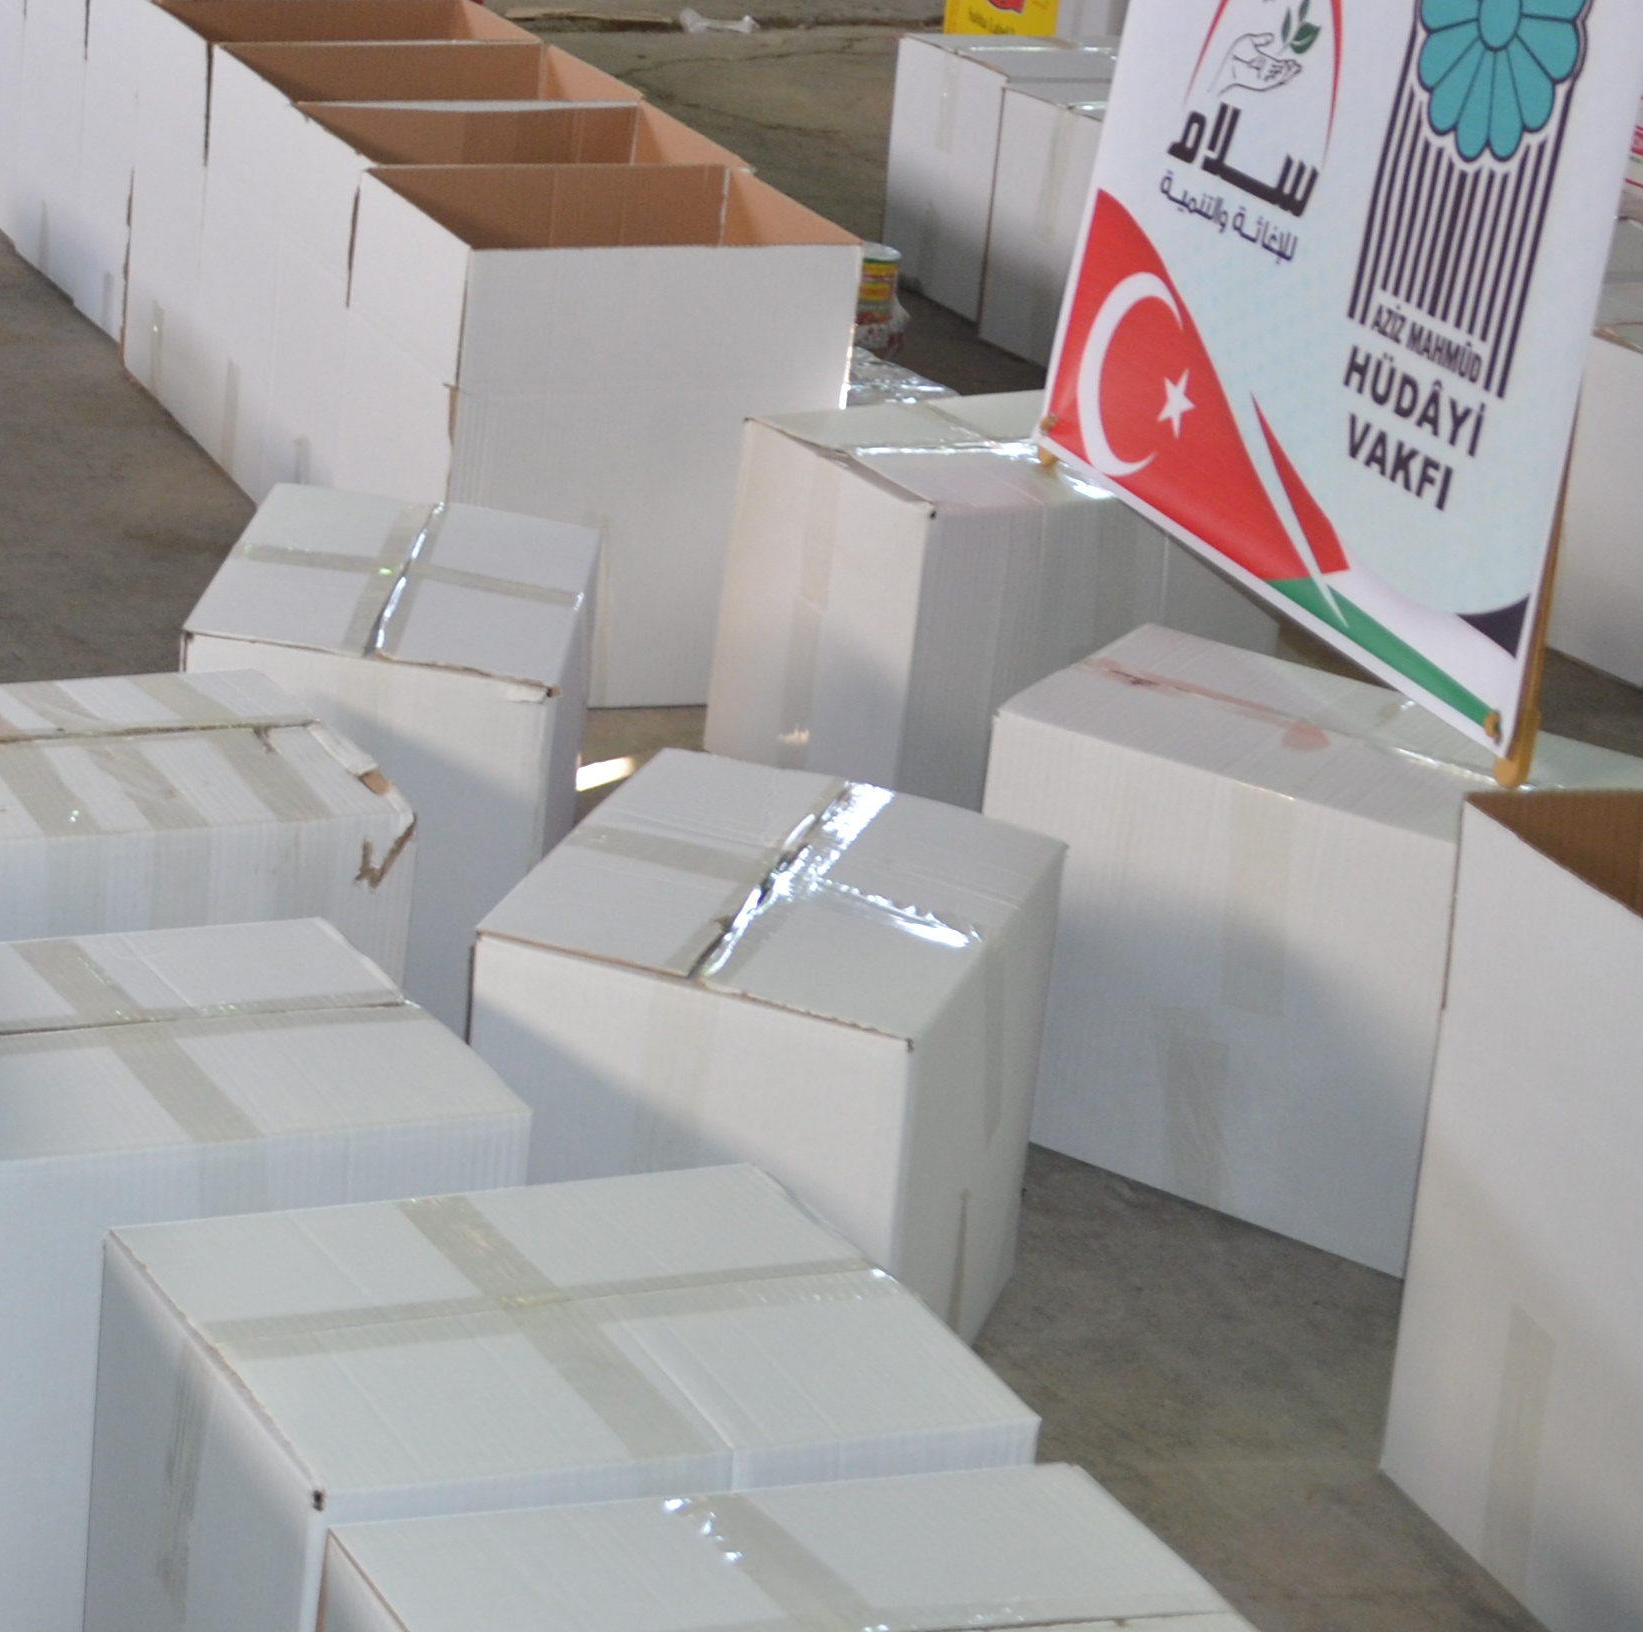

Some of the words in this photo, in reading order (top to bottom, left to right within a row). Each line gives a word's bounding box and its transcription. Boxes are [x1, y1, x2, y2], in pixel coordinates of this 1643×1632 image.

[1371, 304, 1407, 345] AZİZ
[1405, 321, 1483, 384] MAHMÛD
[1343, 344, 1486, 458] HÜDÂYİ
[1348, 412, 1454, 512] VAKFI
